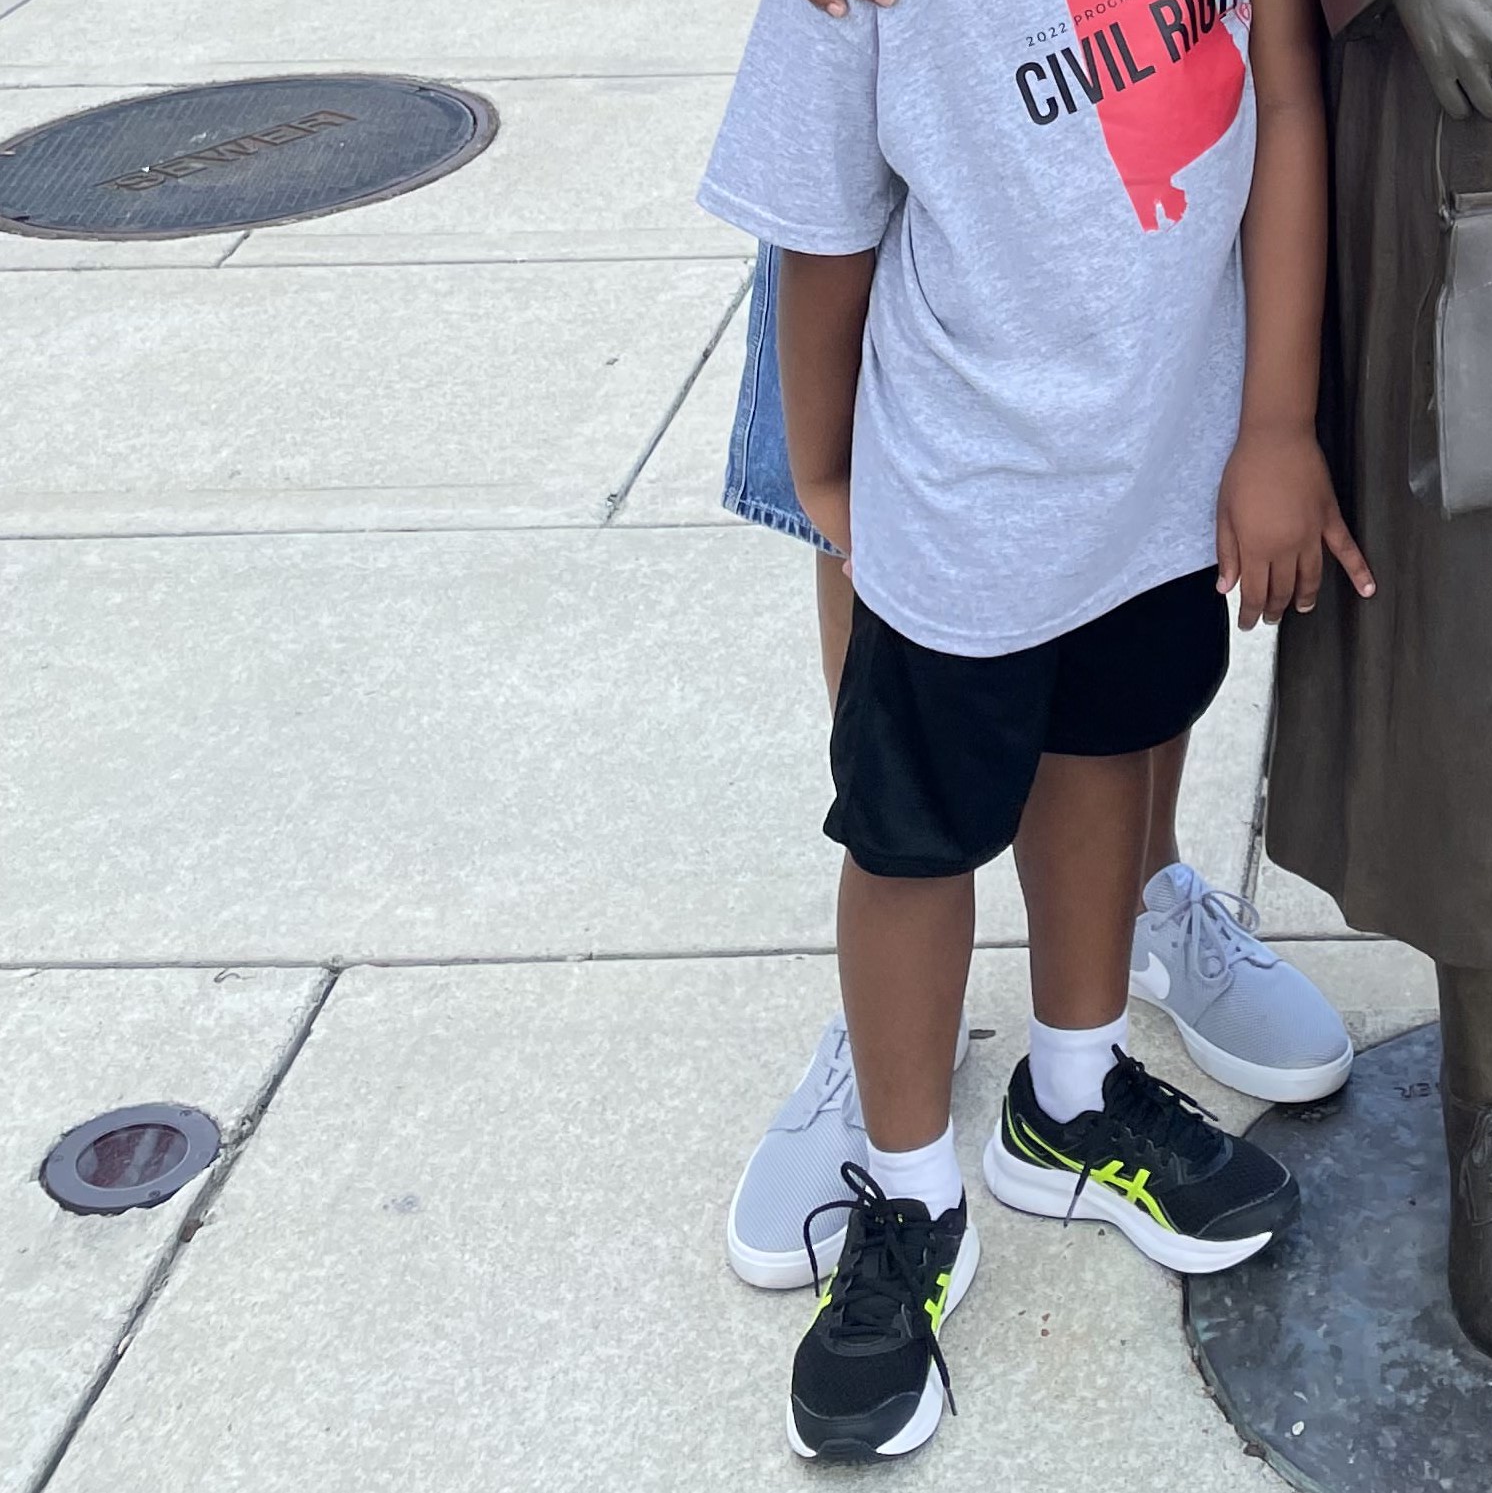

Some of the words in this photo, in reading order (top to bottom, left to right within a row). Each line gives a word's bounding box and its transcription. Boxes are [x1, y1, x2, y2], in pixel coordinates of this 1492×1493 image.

[1015, 21, 1156, 126] CIVIL
[1025, 22, 1069, 48] 2022
[112, 110, 358, 191] SEWER
